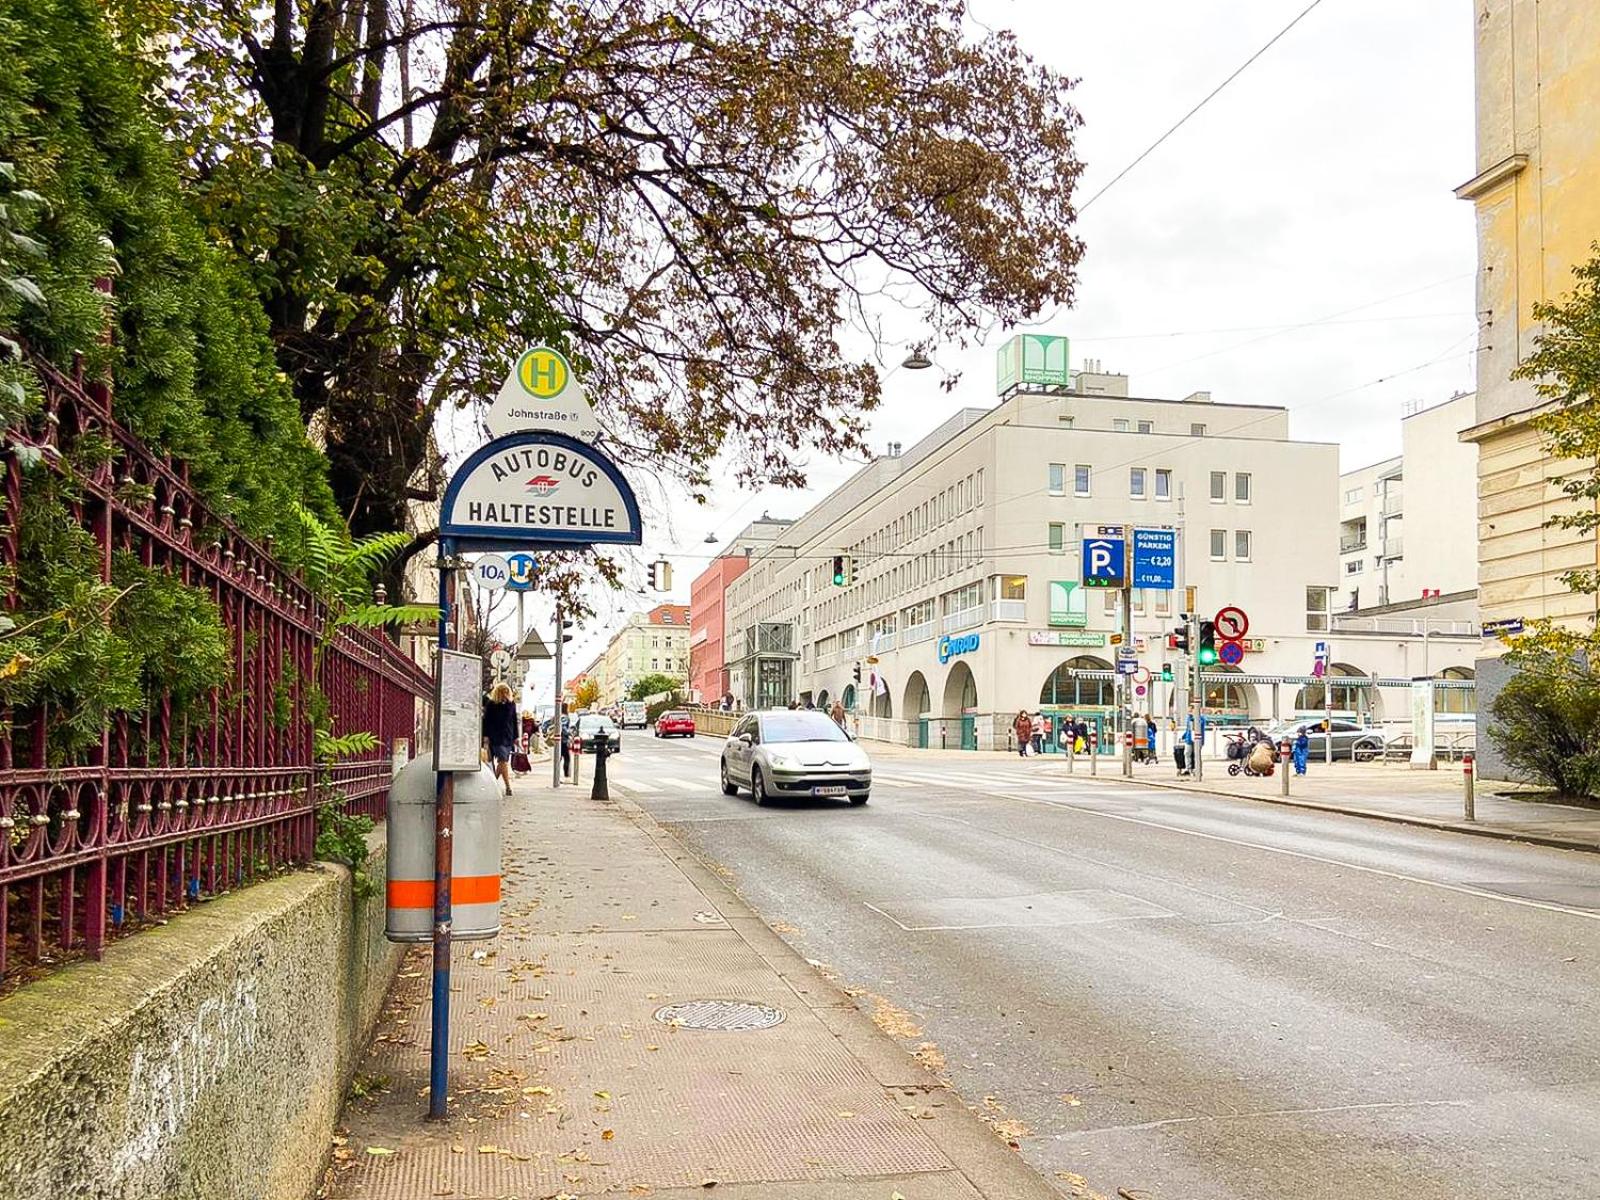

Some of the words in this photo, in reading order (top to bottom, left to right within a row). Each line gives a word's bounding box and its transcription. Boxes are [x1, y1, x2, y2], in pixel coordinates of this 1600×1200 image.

[531, 357, 556, 390] H
[507, 408, 568, 421] Johnstraße
[490, 449, 598, 488] AUTOBUS
[469, 501, 615, 528] HALTESTELLE
[1136, 533, 1172, 541] GÜNSTIG
[1137, 541, 1172, 550] PARKEN!
[479, 564, 505, 580] 10A
[510, 559, 533, 584] U
[1091, 548, 1111, 575] P
